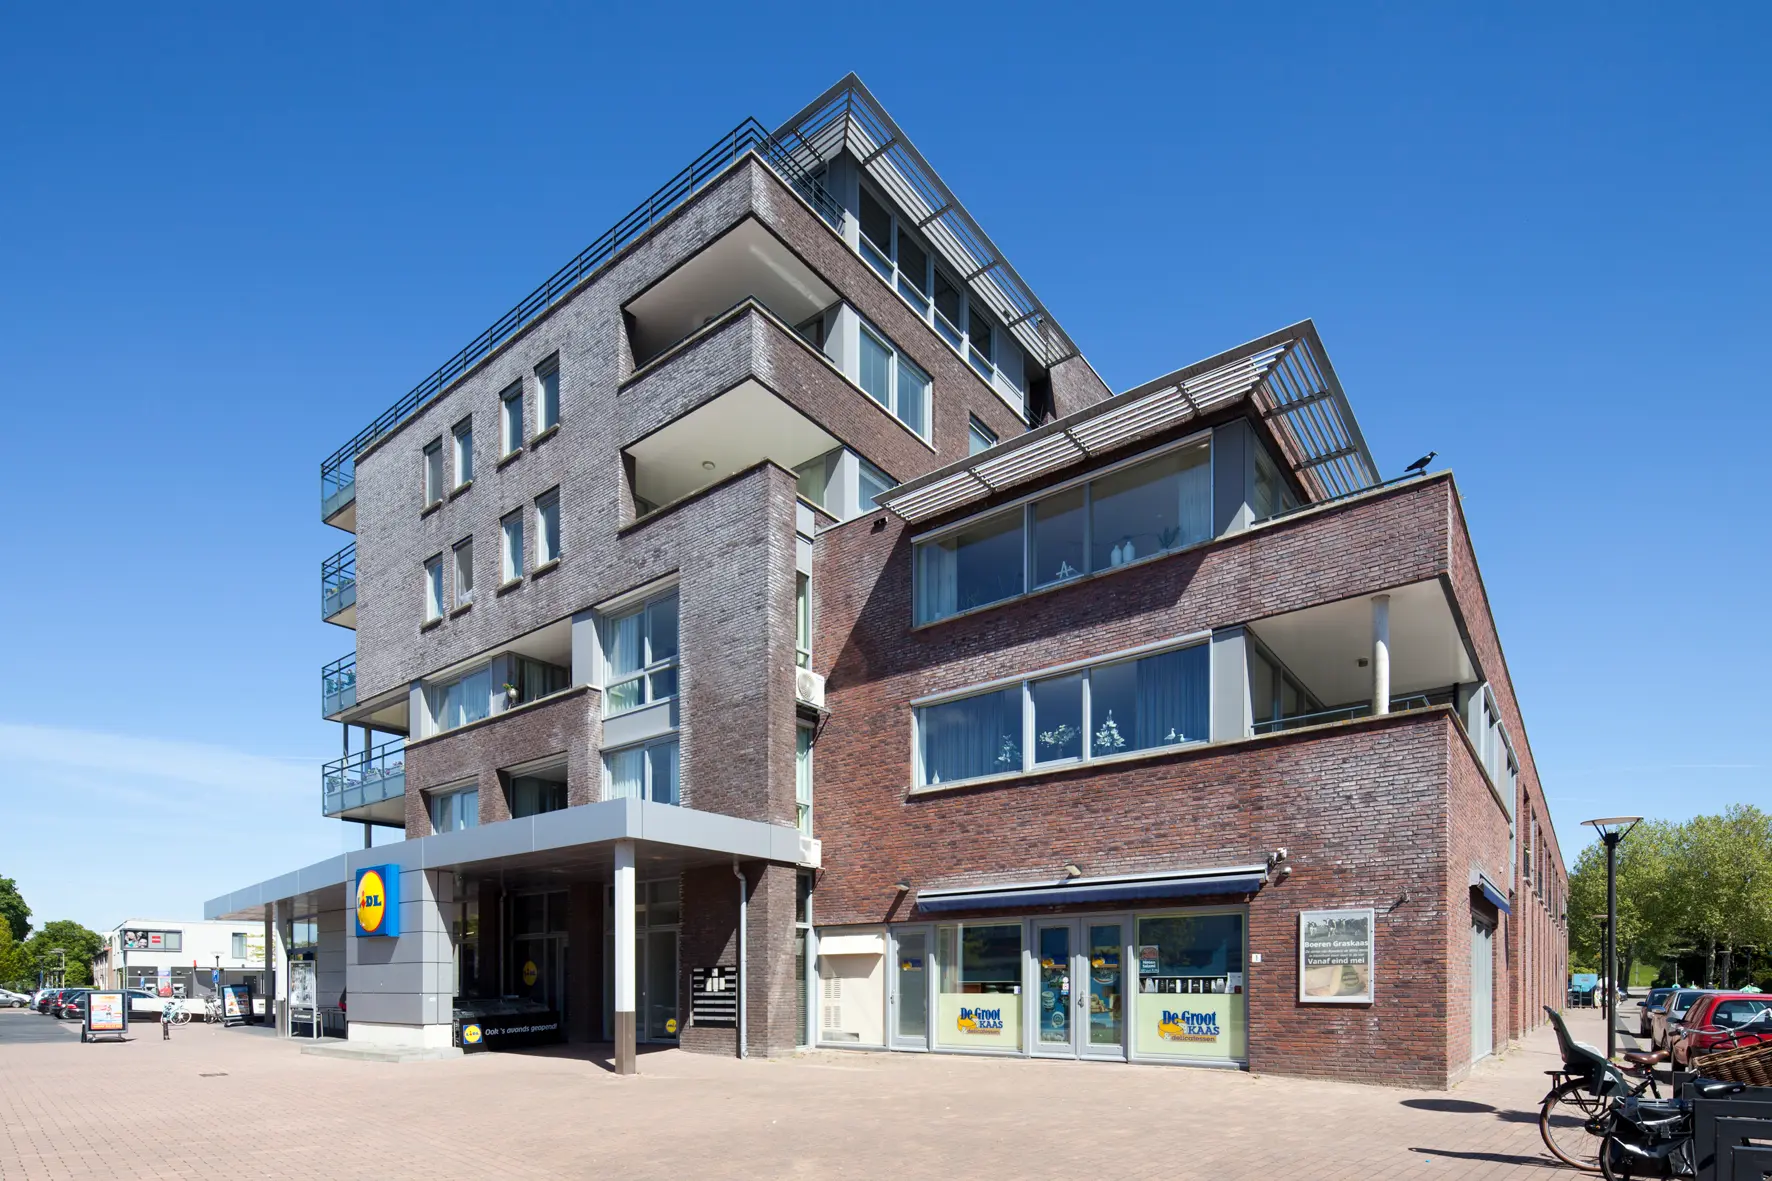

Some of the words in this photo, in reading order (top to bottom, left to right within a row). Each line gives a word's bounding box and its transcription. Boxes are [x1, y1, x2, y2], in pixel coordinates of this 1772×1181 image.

[1307, 957, 1330, 965] Vanaf
[960, 1007, 973, 1020] De
[974, 1007, 1001, 1021] Groot
[1162, 1010, 1179, 1025] De
[1181, 1010, 1217, 1026] Groot
[979, 1020, 1004, 1029] KAAS
[485, 1028, 499, 1036] Ook
[506, 1026, 530, 1034] avonds
[1187, 1025, 1220, 1036] KAAS
